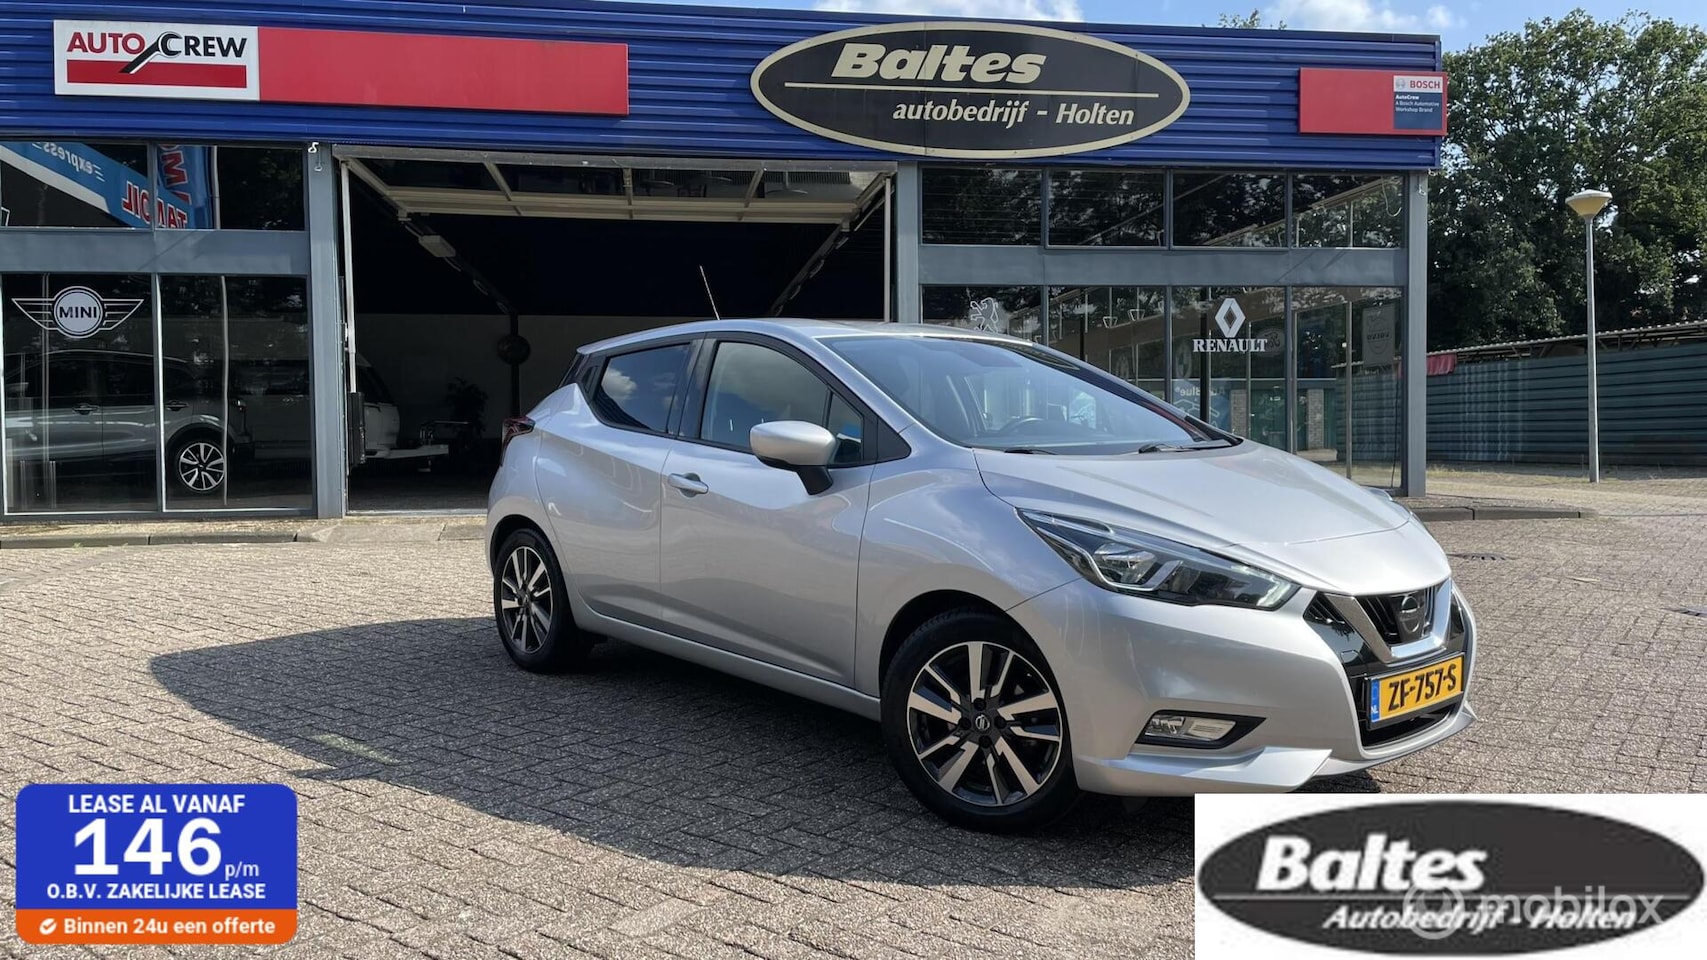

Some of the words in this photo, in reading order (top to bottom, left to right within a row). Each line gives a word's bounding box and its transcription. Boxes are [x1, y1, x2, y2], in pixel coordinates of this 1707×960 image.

[831, 43, 1046, 84] Baltes
[1410, 80, 1440, 89] BOSCH
[893, 100, 1030, 128] autobedrijf
[1056, 103, 1134, 125] Holten
[59, 305, 98, 319] MINI
[1193, 339, 1267, 353] RENAULT
[1388, 663, 1457, 712] ZF-757-S
[1370, 704, 1379, 714] NL
